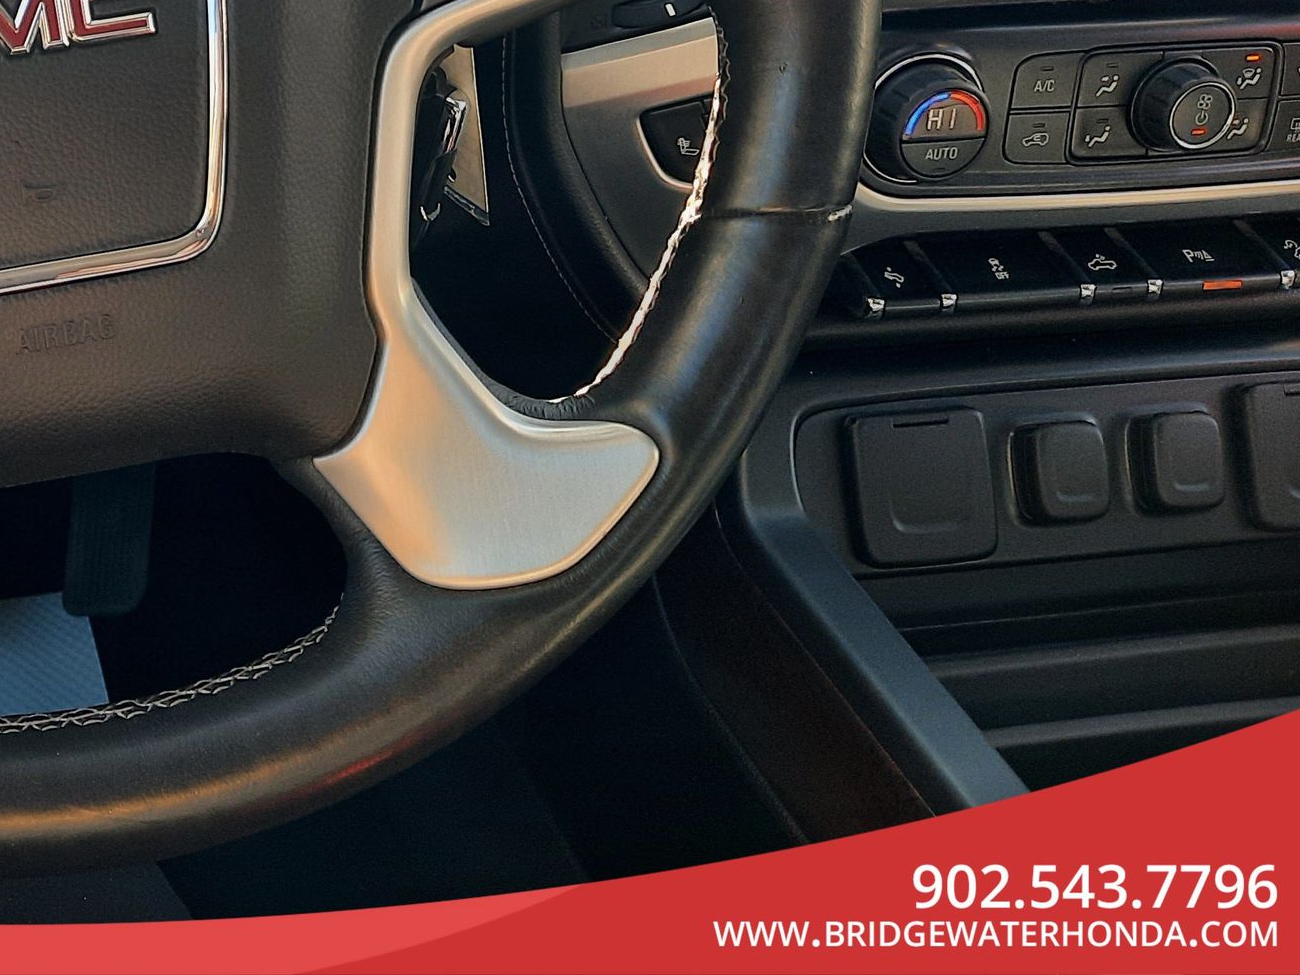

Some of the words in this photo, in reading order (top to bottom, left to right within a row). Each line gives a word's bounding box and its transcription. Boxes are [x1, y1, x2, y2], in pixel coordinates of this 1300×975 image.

[1033, 78, 1056, 94] A/C
[924, 146, 958, 162] AUTO
[15, 313, 117, 355] AIRBAG
